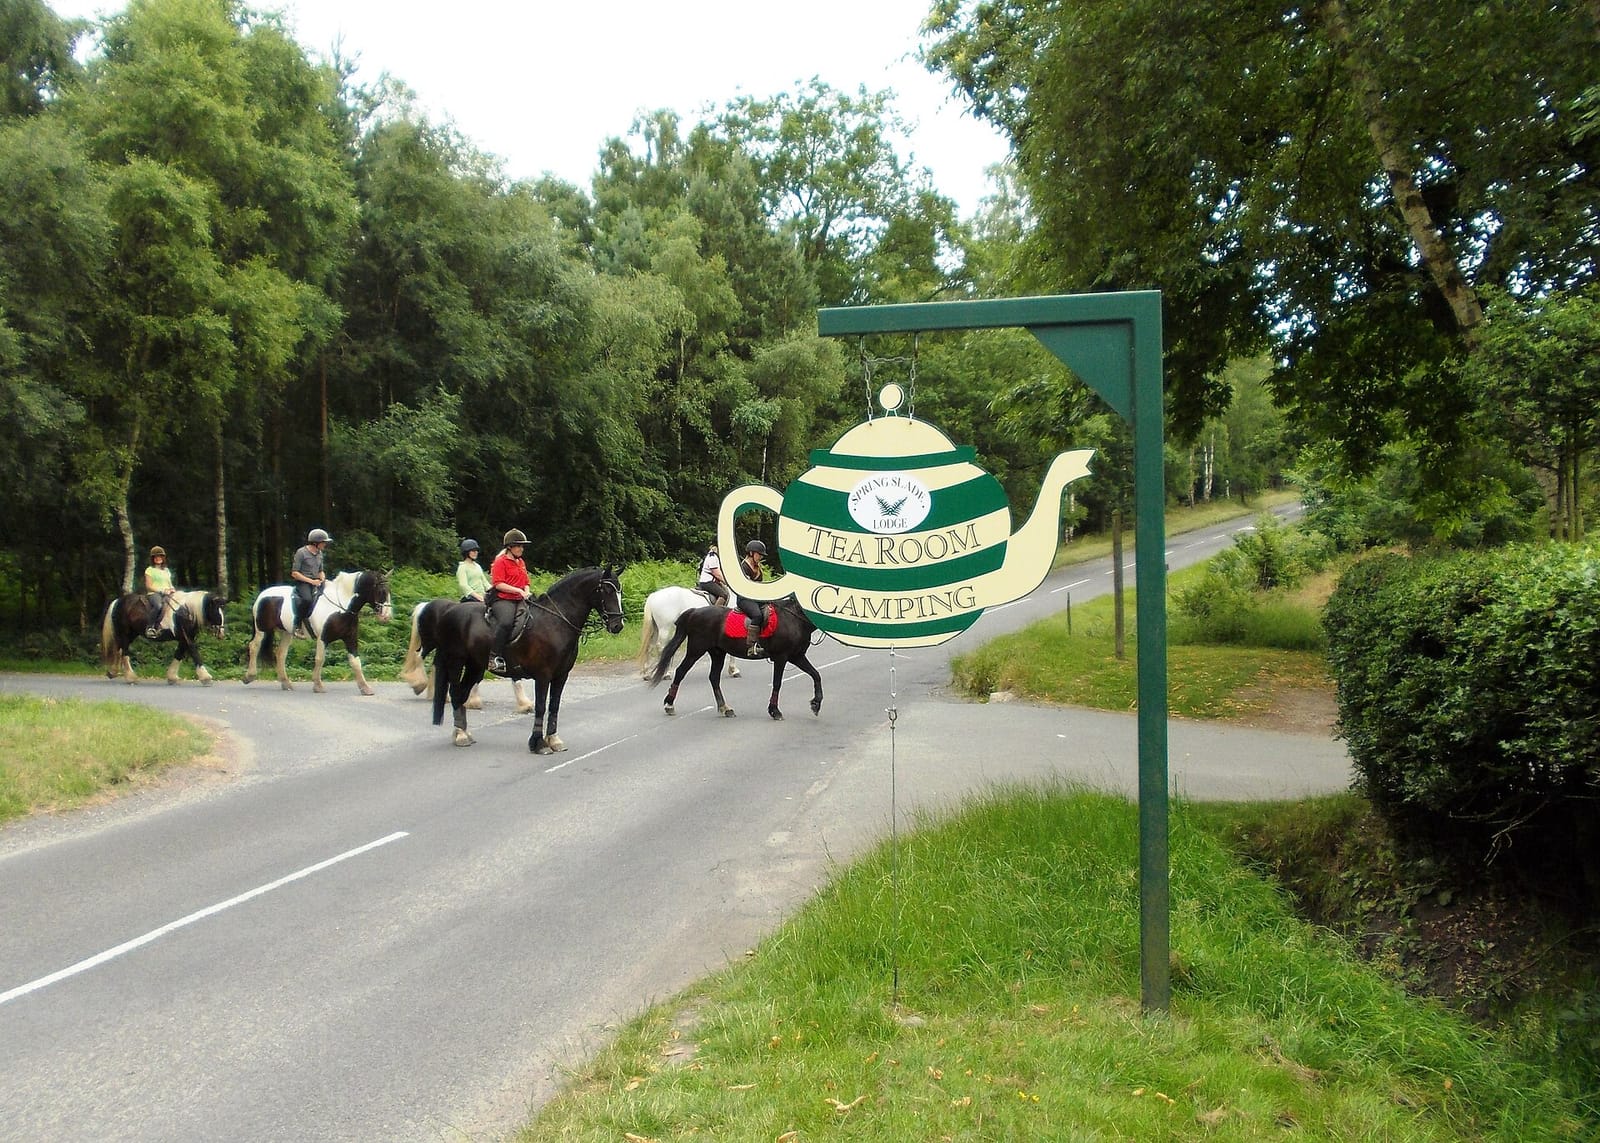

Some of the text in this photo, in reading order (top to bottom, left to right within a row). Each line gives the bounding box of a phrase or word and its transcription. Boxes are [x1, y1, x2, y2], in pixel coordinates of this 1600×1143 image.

[851, 477, 926, 505] SPRING SLADE
[873, 518, 908, 529] LODGE
[807, 523, 981, 565] TEA ROOM
[810, 585, 976, 620] CAMPING
